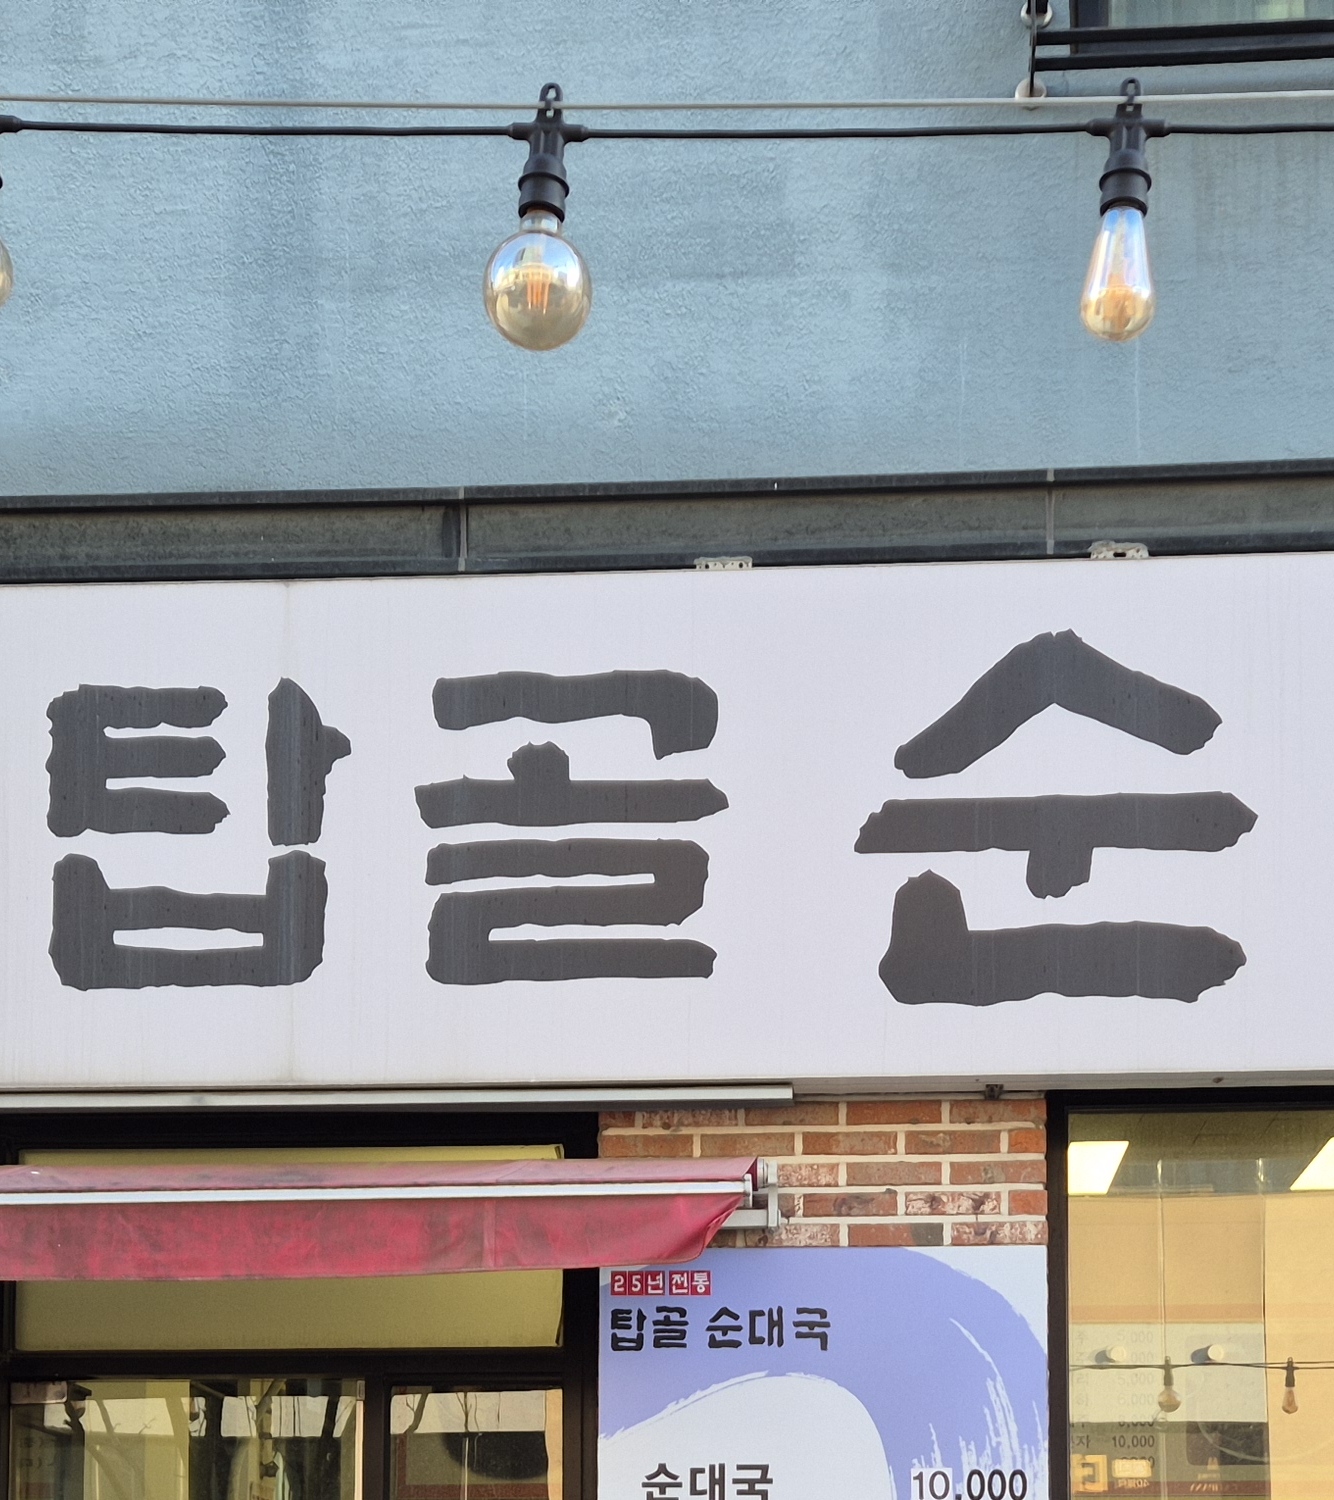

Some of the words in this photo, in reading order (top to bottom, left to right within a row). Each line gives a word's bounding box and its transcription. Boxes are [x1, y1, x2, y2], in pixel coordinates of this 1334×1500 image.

[47, 668, 730, 992] 탑골
[613, 1271, 665, 1294] 25년
[671, 1271, 710, 1294] 전통
[610, 1305, 690, 1352] 탑골
[705, 1305, 832, 1351] 순대국
[1111, 1435, 1156, 1449] 10,000
